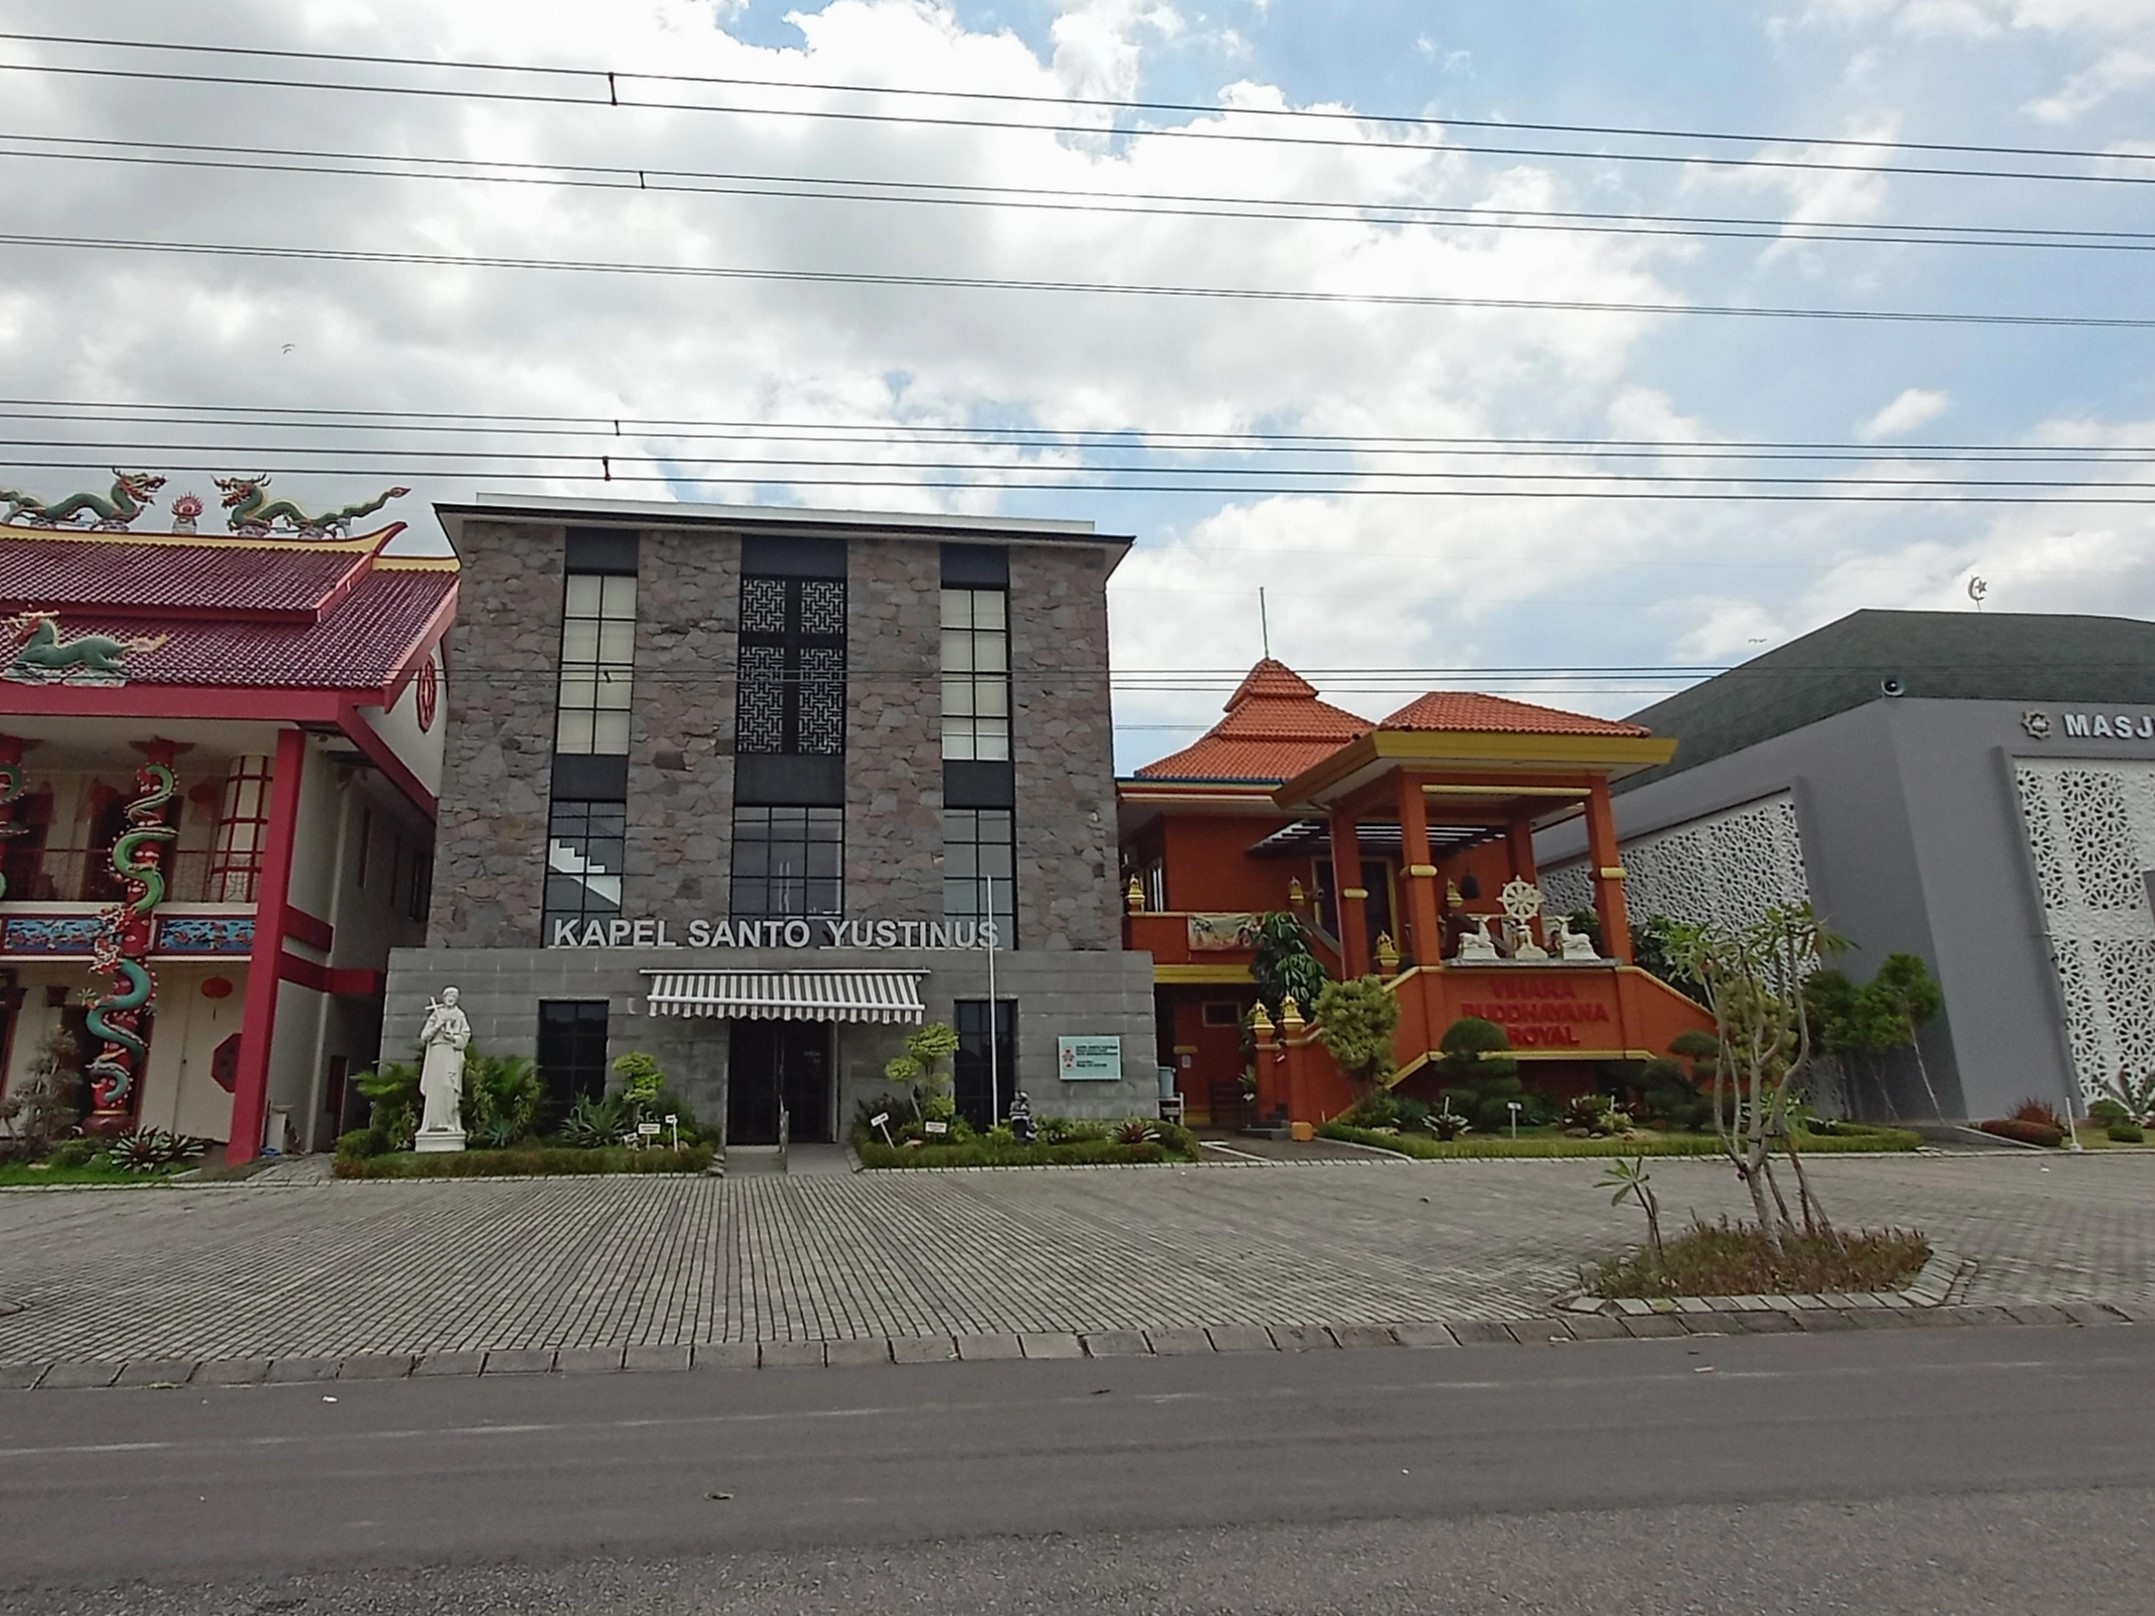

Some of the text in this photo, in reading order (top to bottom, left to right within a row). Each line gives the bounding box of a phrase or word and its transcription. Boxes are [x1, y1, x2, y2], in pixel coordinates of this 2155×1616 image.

[2063, 713, 2155, 739] MASJ
[553, 918, 1000, 950] KAPEL SANTO YUSTINUS
[1488, 978, 1577, 999] VIHARA
[1460, 1001, 1610, 1023] BUDDHAYANA
[1505, 1023, 1581, 1046] ROYAL
